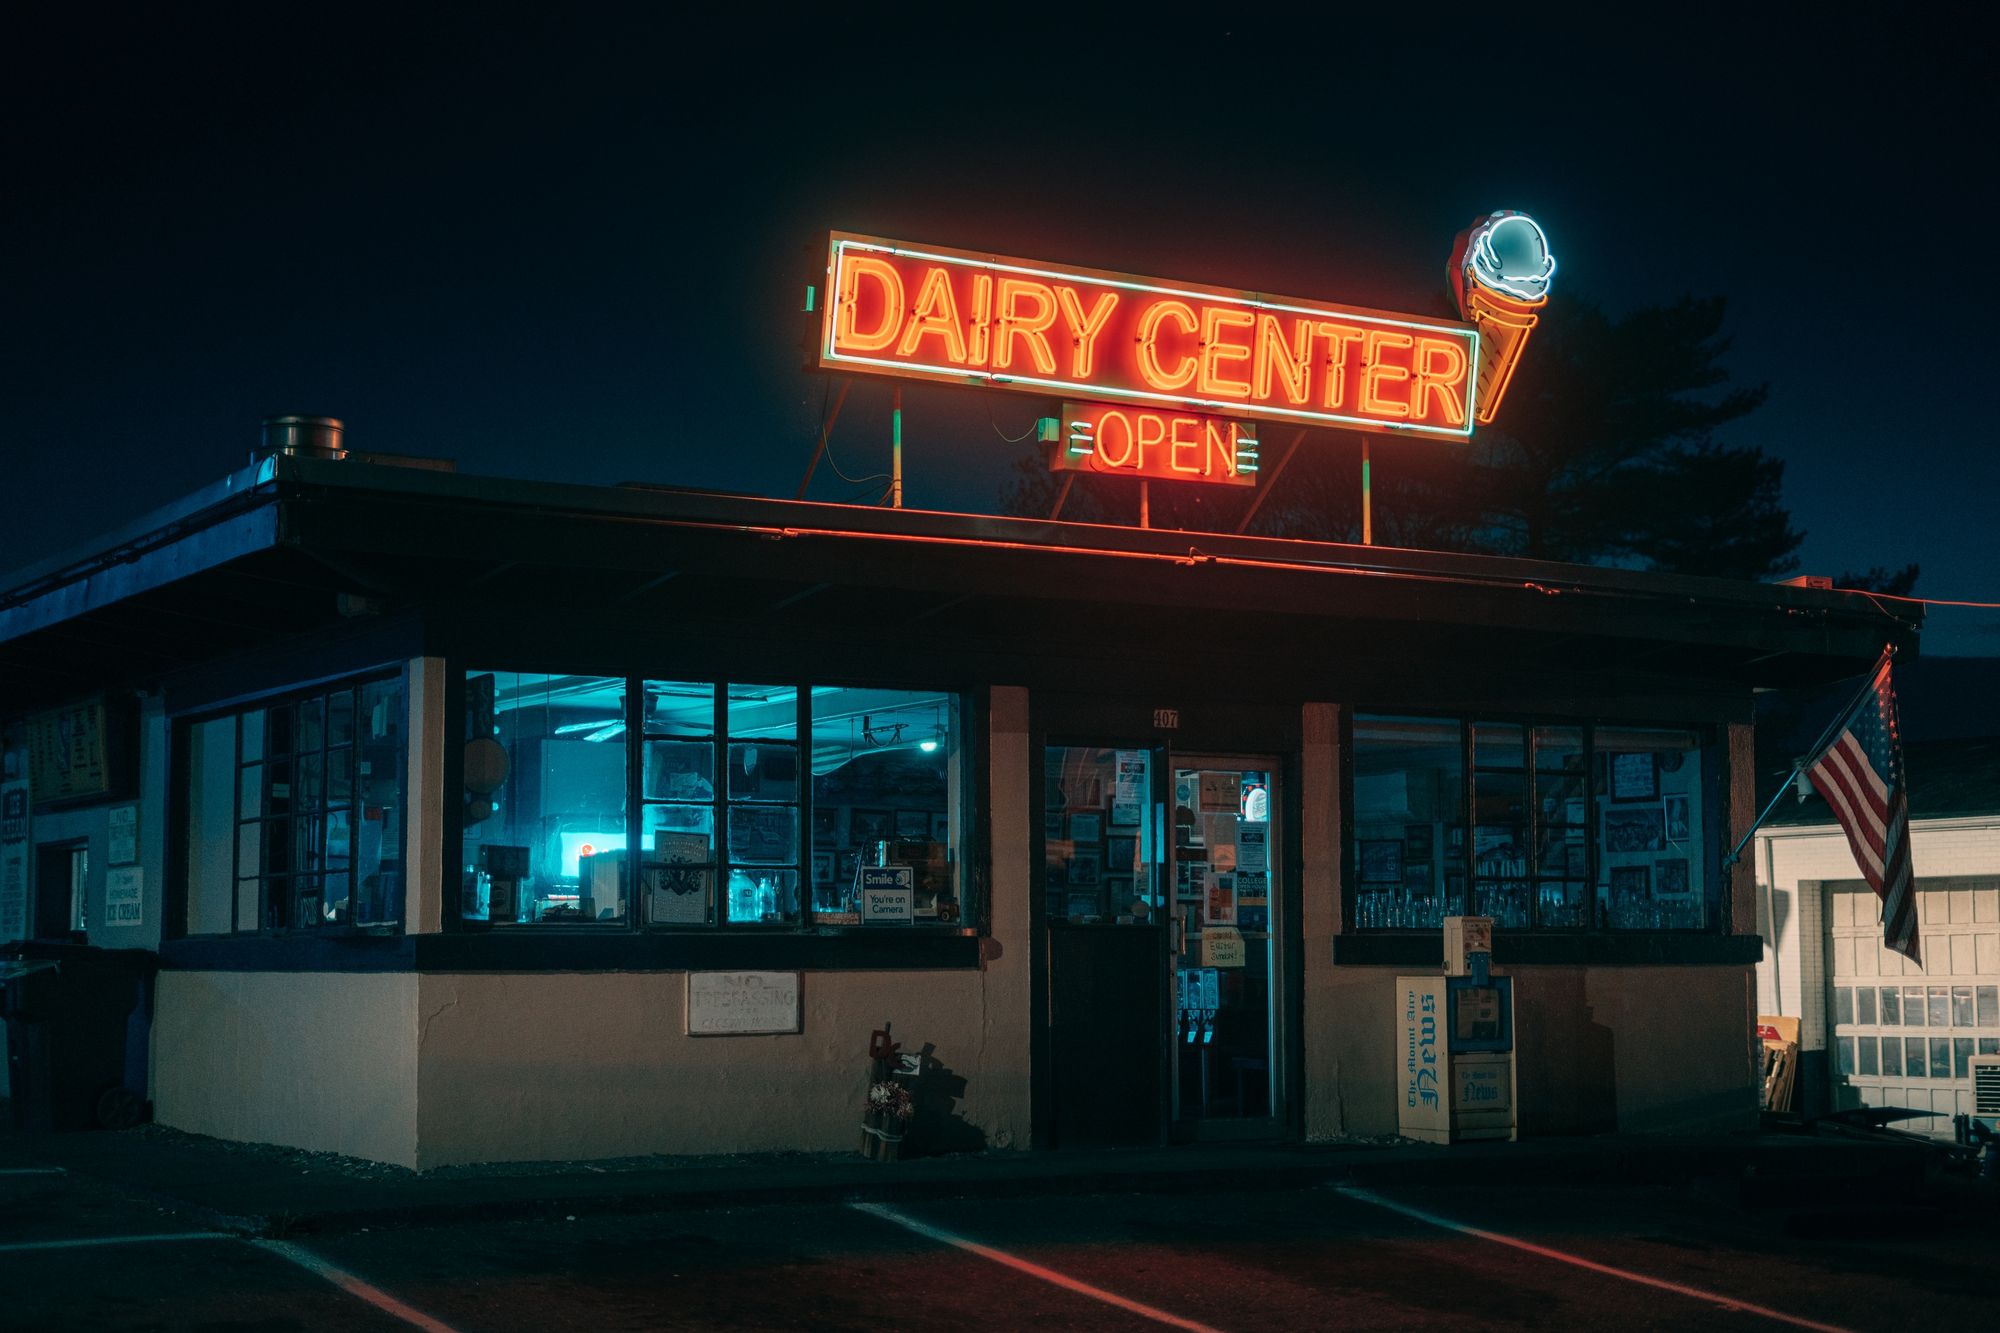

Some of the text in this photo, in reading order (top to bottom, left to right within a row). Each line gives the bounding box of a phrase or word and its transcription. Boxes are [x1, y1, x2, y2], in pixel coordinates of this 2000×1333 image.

[838, 256, 1468, 425] DAIRY CENTER
[1096, 411, 1238, 477] OPEN
[1153, 711, 1177, 727] 407
[865, 874, 893, 885] Smile
[870, 895, 893, 904] You're
[872, 905, 903, 913] Camera
[107, 903, 141, 921] ICE CREAM
[1407, 991, 1416, 1107] The Mount Airy
[1416, 994, 1438, 1113] News
[1462, 1082, 1498, 1102] News
